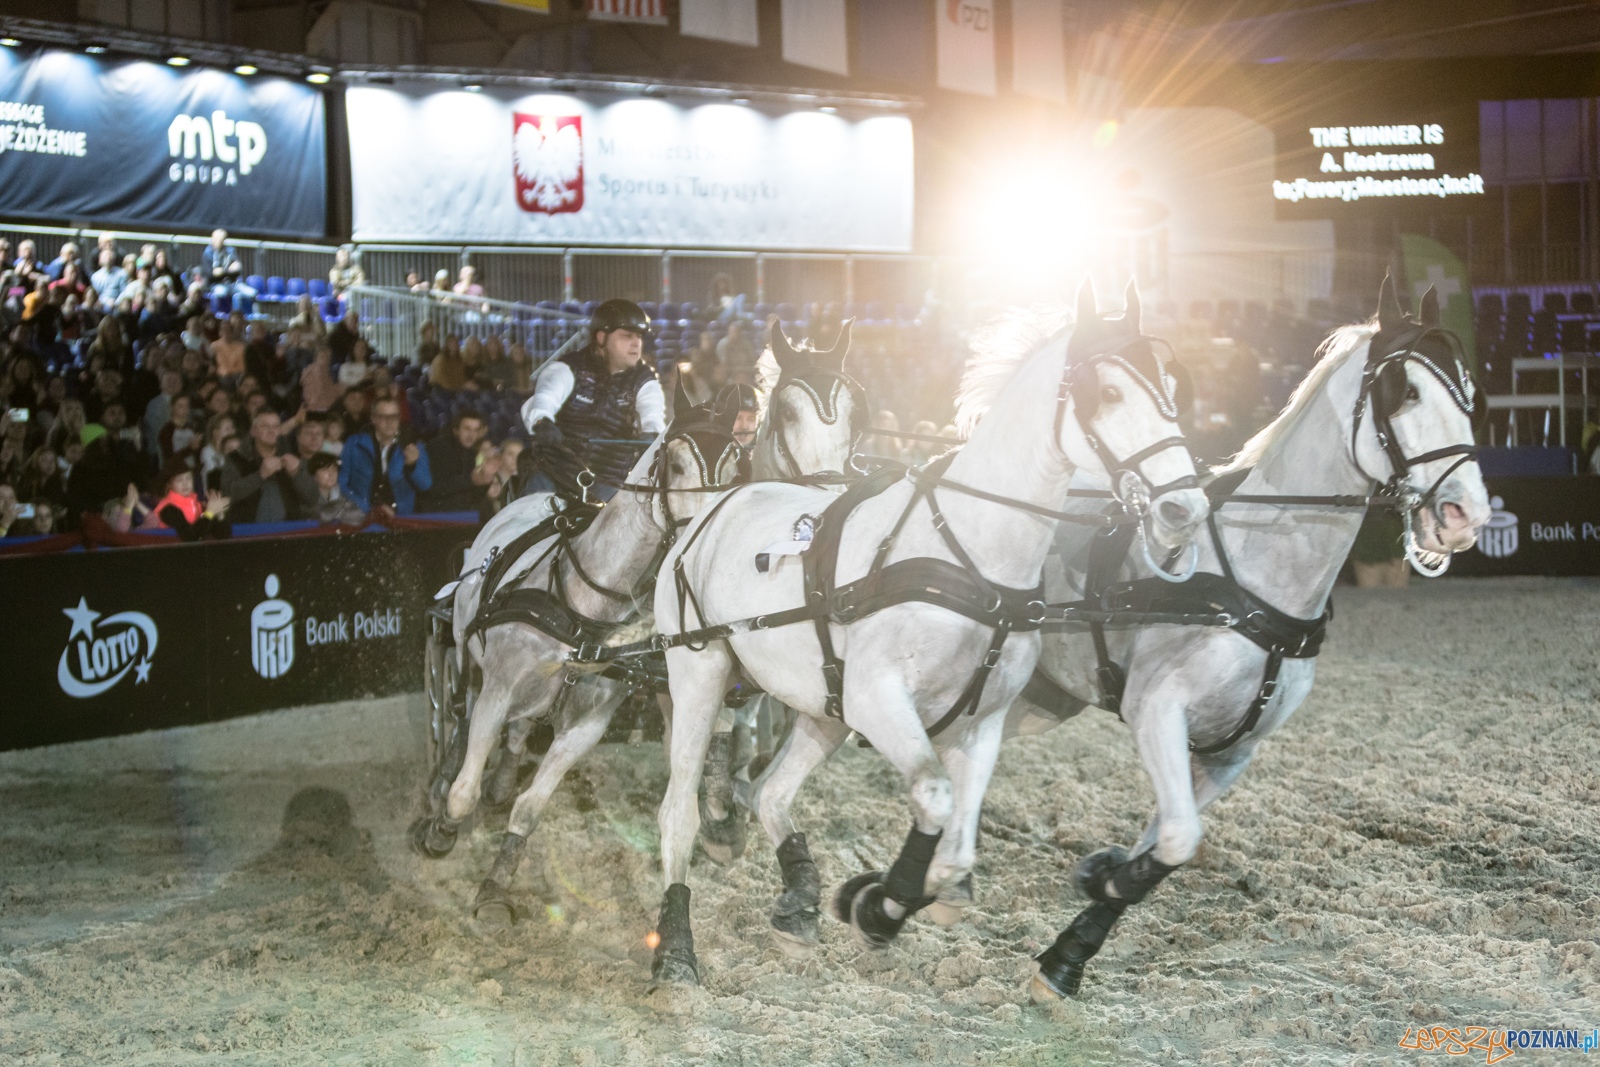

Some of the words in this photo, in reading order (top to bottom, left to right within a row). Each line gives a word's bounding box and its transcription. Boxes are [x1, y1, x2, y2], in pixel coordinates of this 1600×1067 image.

[168, 110, 267, 175] mtp
[1310, 127, 1349, 147] THE
[1349, 125, 1421, 146] WINNER
[1423, 124, 1444, 145] IS
[169, 163, 238, 186] GRUPA
[1320, 152, 1342, 173] A.
[598, 172, 667, 199] Sportu
[674, 175, 682, 198] i
[690, 175, 779, 202] Turystyki
[1531, 522, 1576, 541] Bank
[306, 616, 349, 646] Bank
[354, 608, 401, 640] Polski
[77, 626, 139, 680] LOTTO
